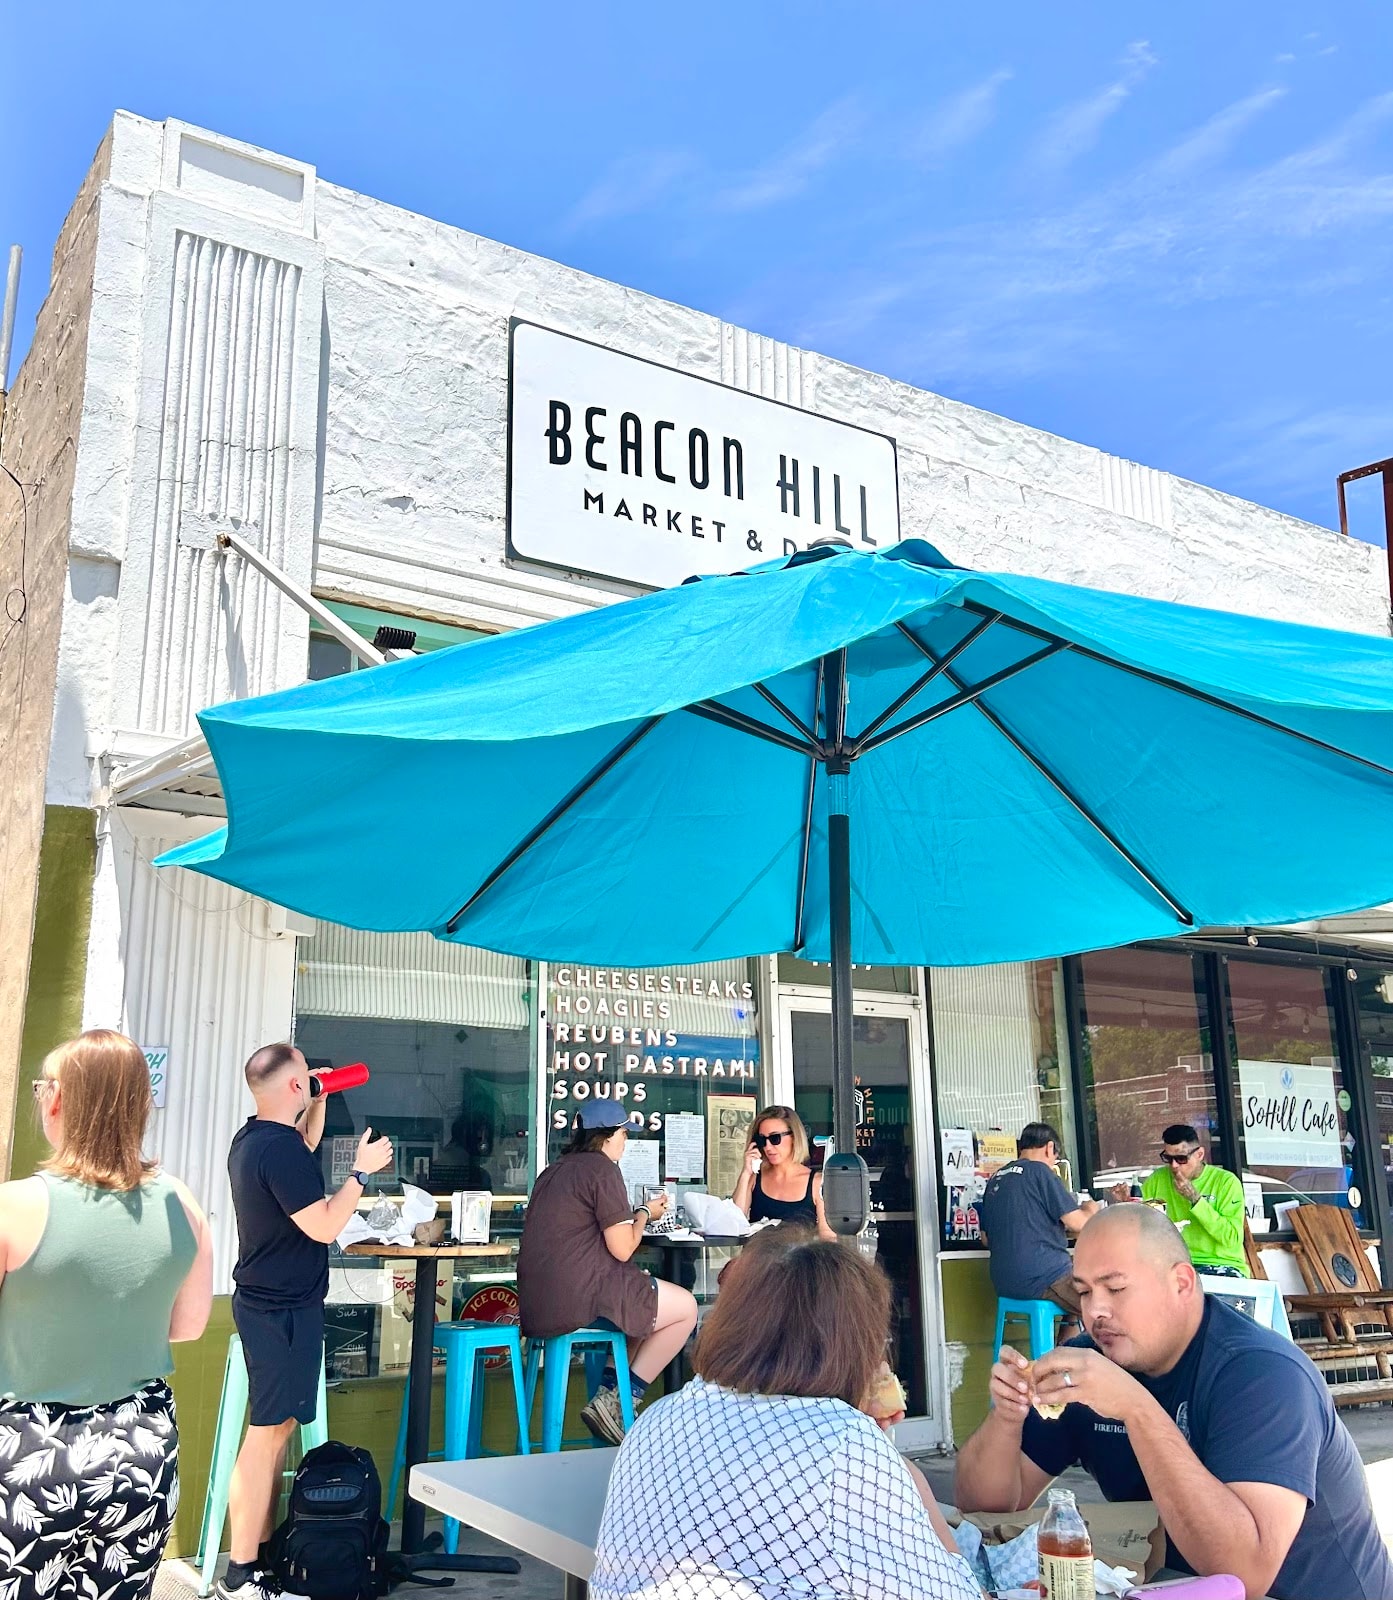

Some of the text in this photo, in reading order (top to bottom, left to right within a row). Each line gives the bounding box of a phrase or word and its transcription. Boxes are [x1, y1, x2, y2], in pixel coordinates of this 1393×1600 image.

[544, 400, 877, 546] BEACON HILL
[583, 488, 726, 543] MARKET
[746, 529, 763, 553] &
[557, 968, 753, 999] CHEESESTEAKS
[556, 995, 671, 1020] HOAGIES
[555, 1023, 678, 1047] REUBENS
[554, 1051, 755, 1078] HOT PASTRAMI
[553, 1080, 647, 1102] SOUPS
[553, 1109, 663, 1131] SDS
[1245, 1096, 1337, 1137] SoHill Cafe
[855, 1139, 871, 1147] ELI
[856, 1129, 875, 1137] KET
[981, 1146, 1015, 1154] TASTEMAKER
[869, 1201, 885, 1211] 1-4
[470, 1291, 517, 1312] ICE COLD
